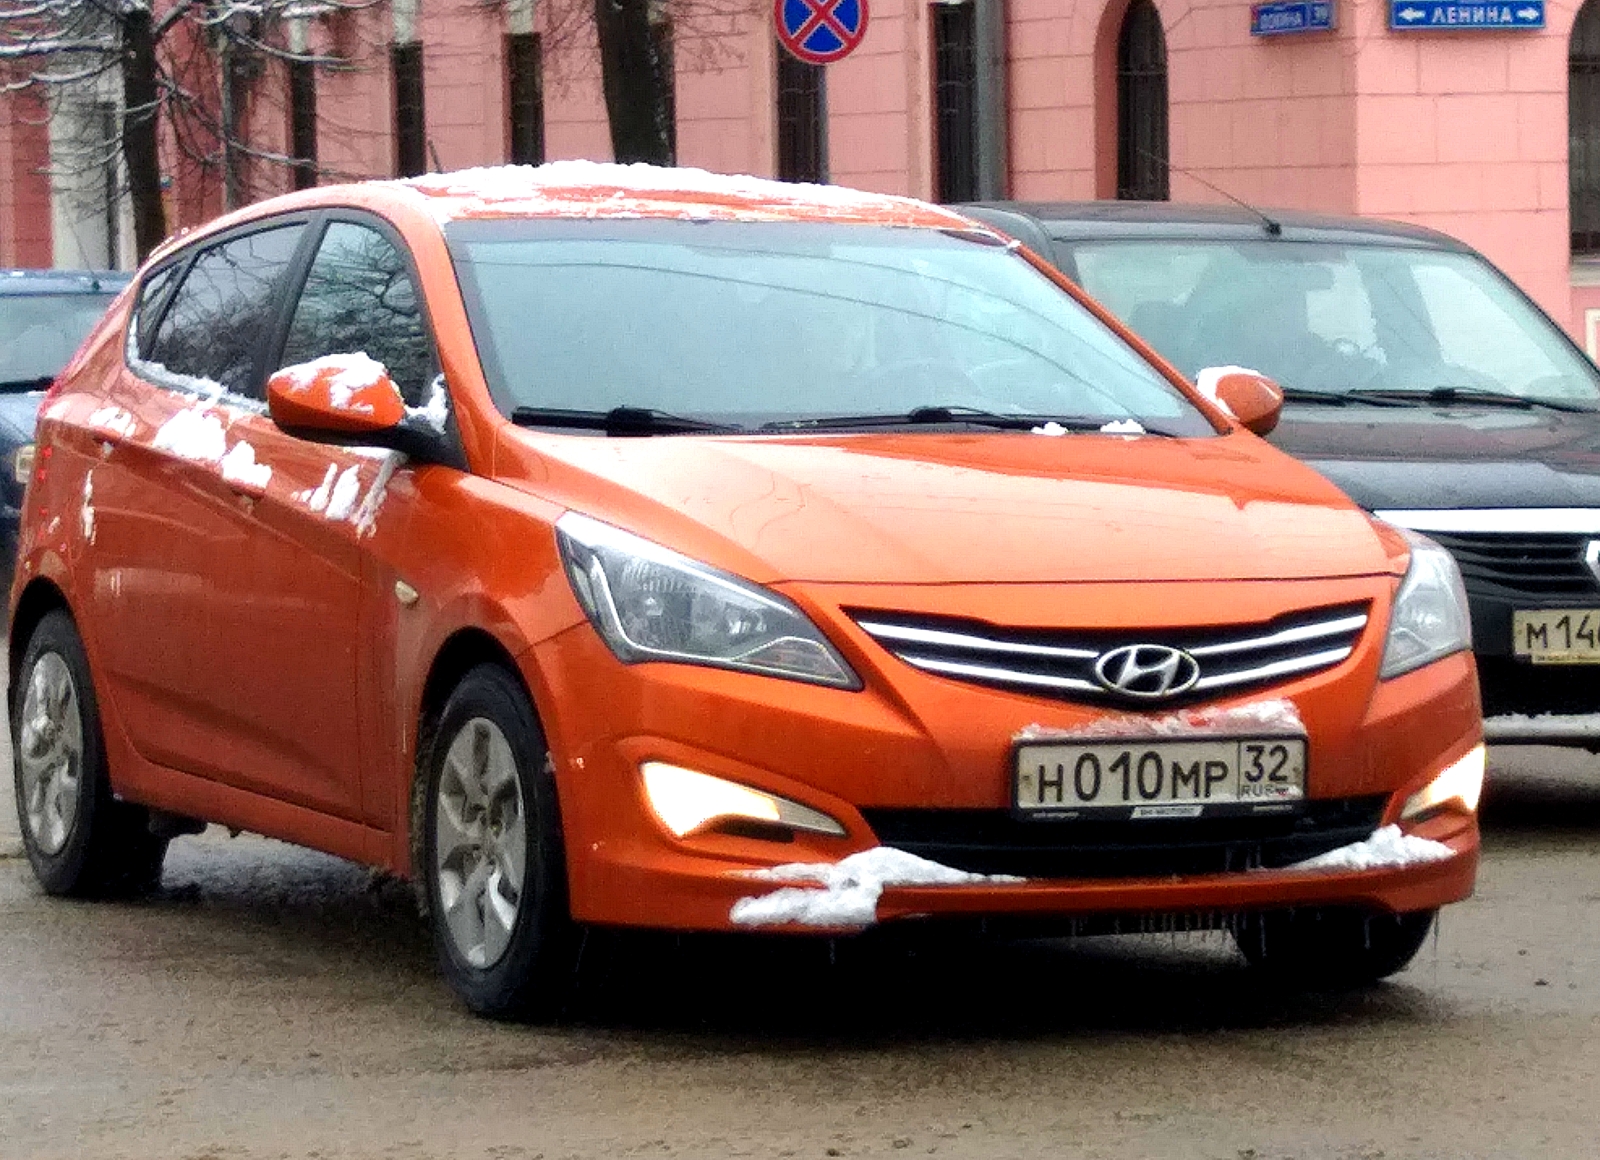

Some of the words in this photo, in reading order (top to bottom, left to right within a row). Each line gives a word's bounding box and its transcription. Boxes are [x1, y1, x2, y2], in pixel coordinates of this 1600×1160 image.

[1432, 6, 1513, 24] ЛЕНИНА
[1526, 613, 1600, 649] М14
[1038, 750, 1230, 803] Н010МР
[1244, 744, 1289, 783] 32
